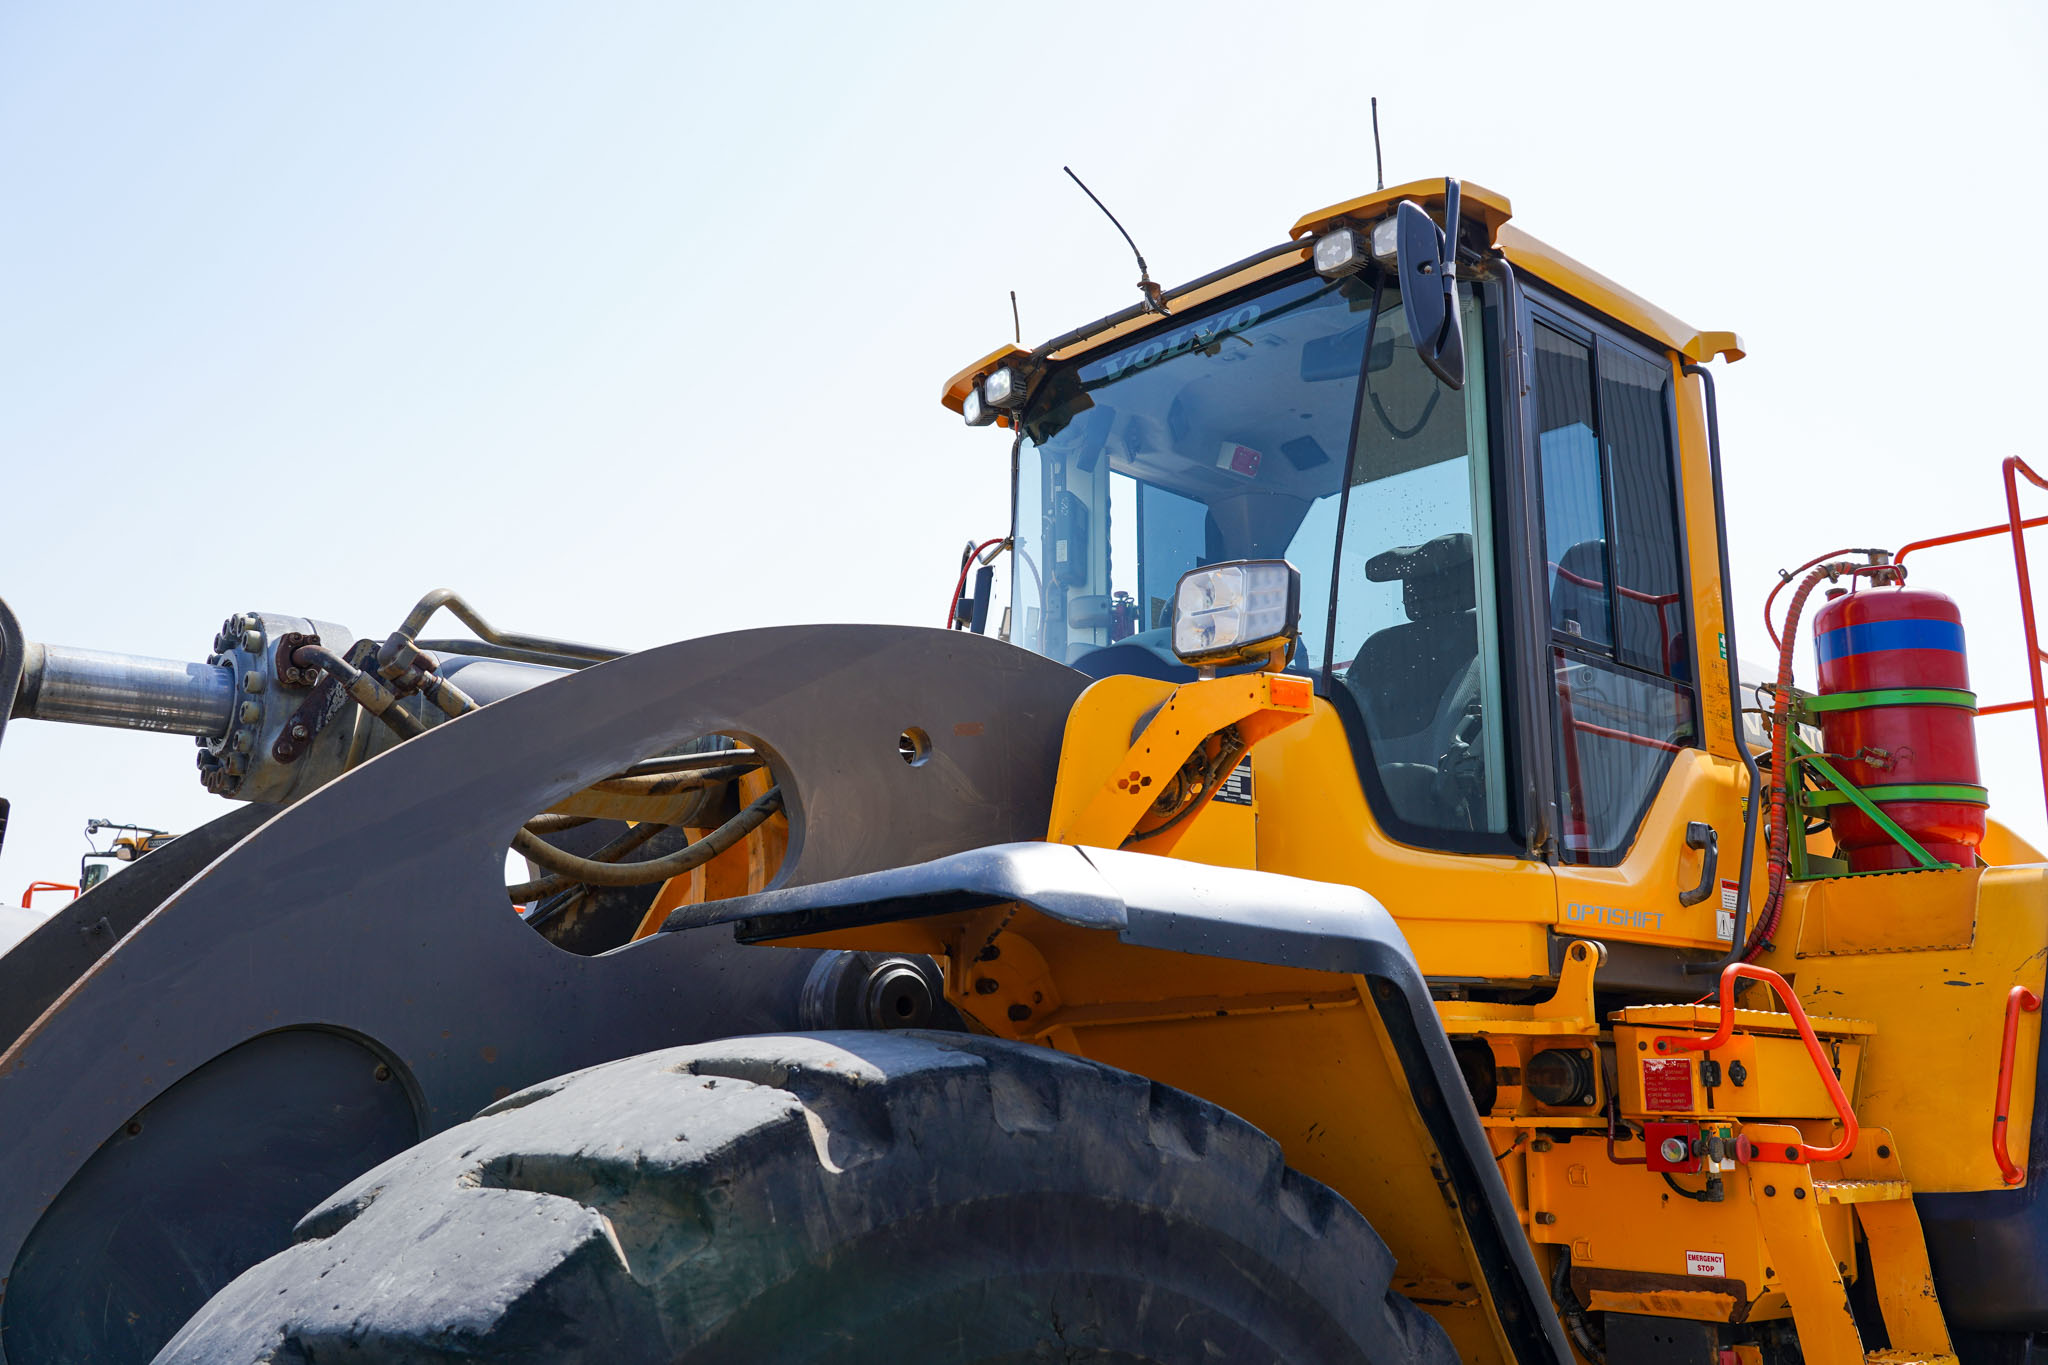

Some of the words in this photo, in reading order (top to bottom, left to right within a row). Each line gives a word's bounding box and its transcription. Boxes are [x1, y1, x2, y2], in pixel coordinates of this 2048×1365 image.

[1101, 304, 1262, 381] VOLVO
[1567, 903, 1664, 928] OPTISHIFT
[1688, 1254, 1722, 1263] EMERGENCY
[1697, 1264, 1715, 1272] STOP
